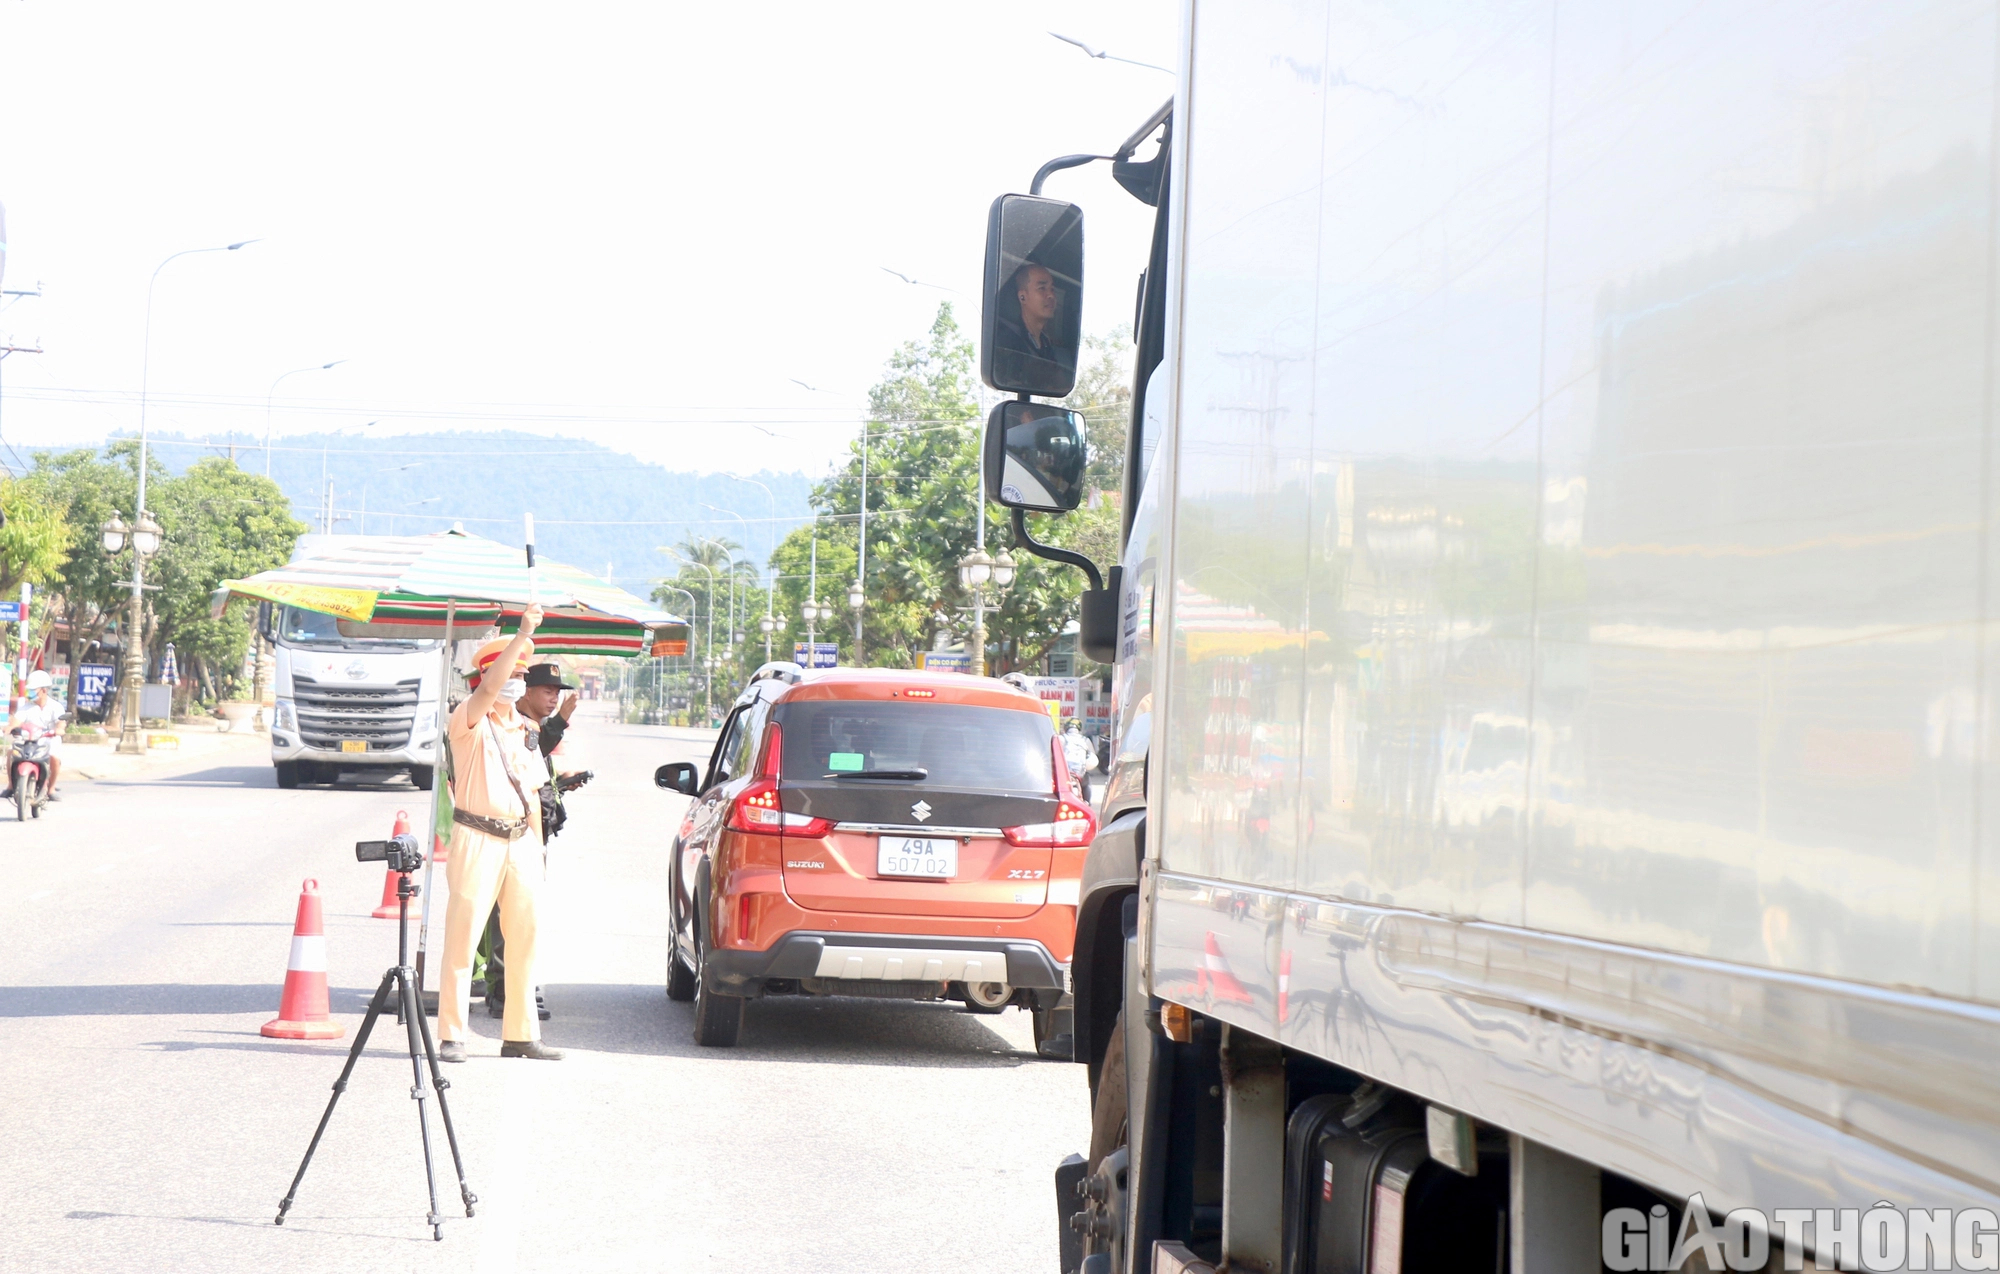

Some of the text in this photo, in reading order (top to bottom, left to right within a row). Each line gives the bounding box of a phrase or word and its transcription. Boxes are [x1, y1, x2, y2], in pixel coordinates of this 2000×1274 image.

[83, 676, 108, 695] IN
[901, 838, 934, 856] 49A
[786, 860, 825, 869] SUZUKI
[887, 856, 947, 875] 507.02
[1007, 868, 1045, 879] XL7
